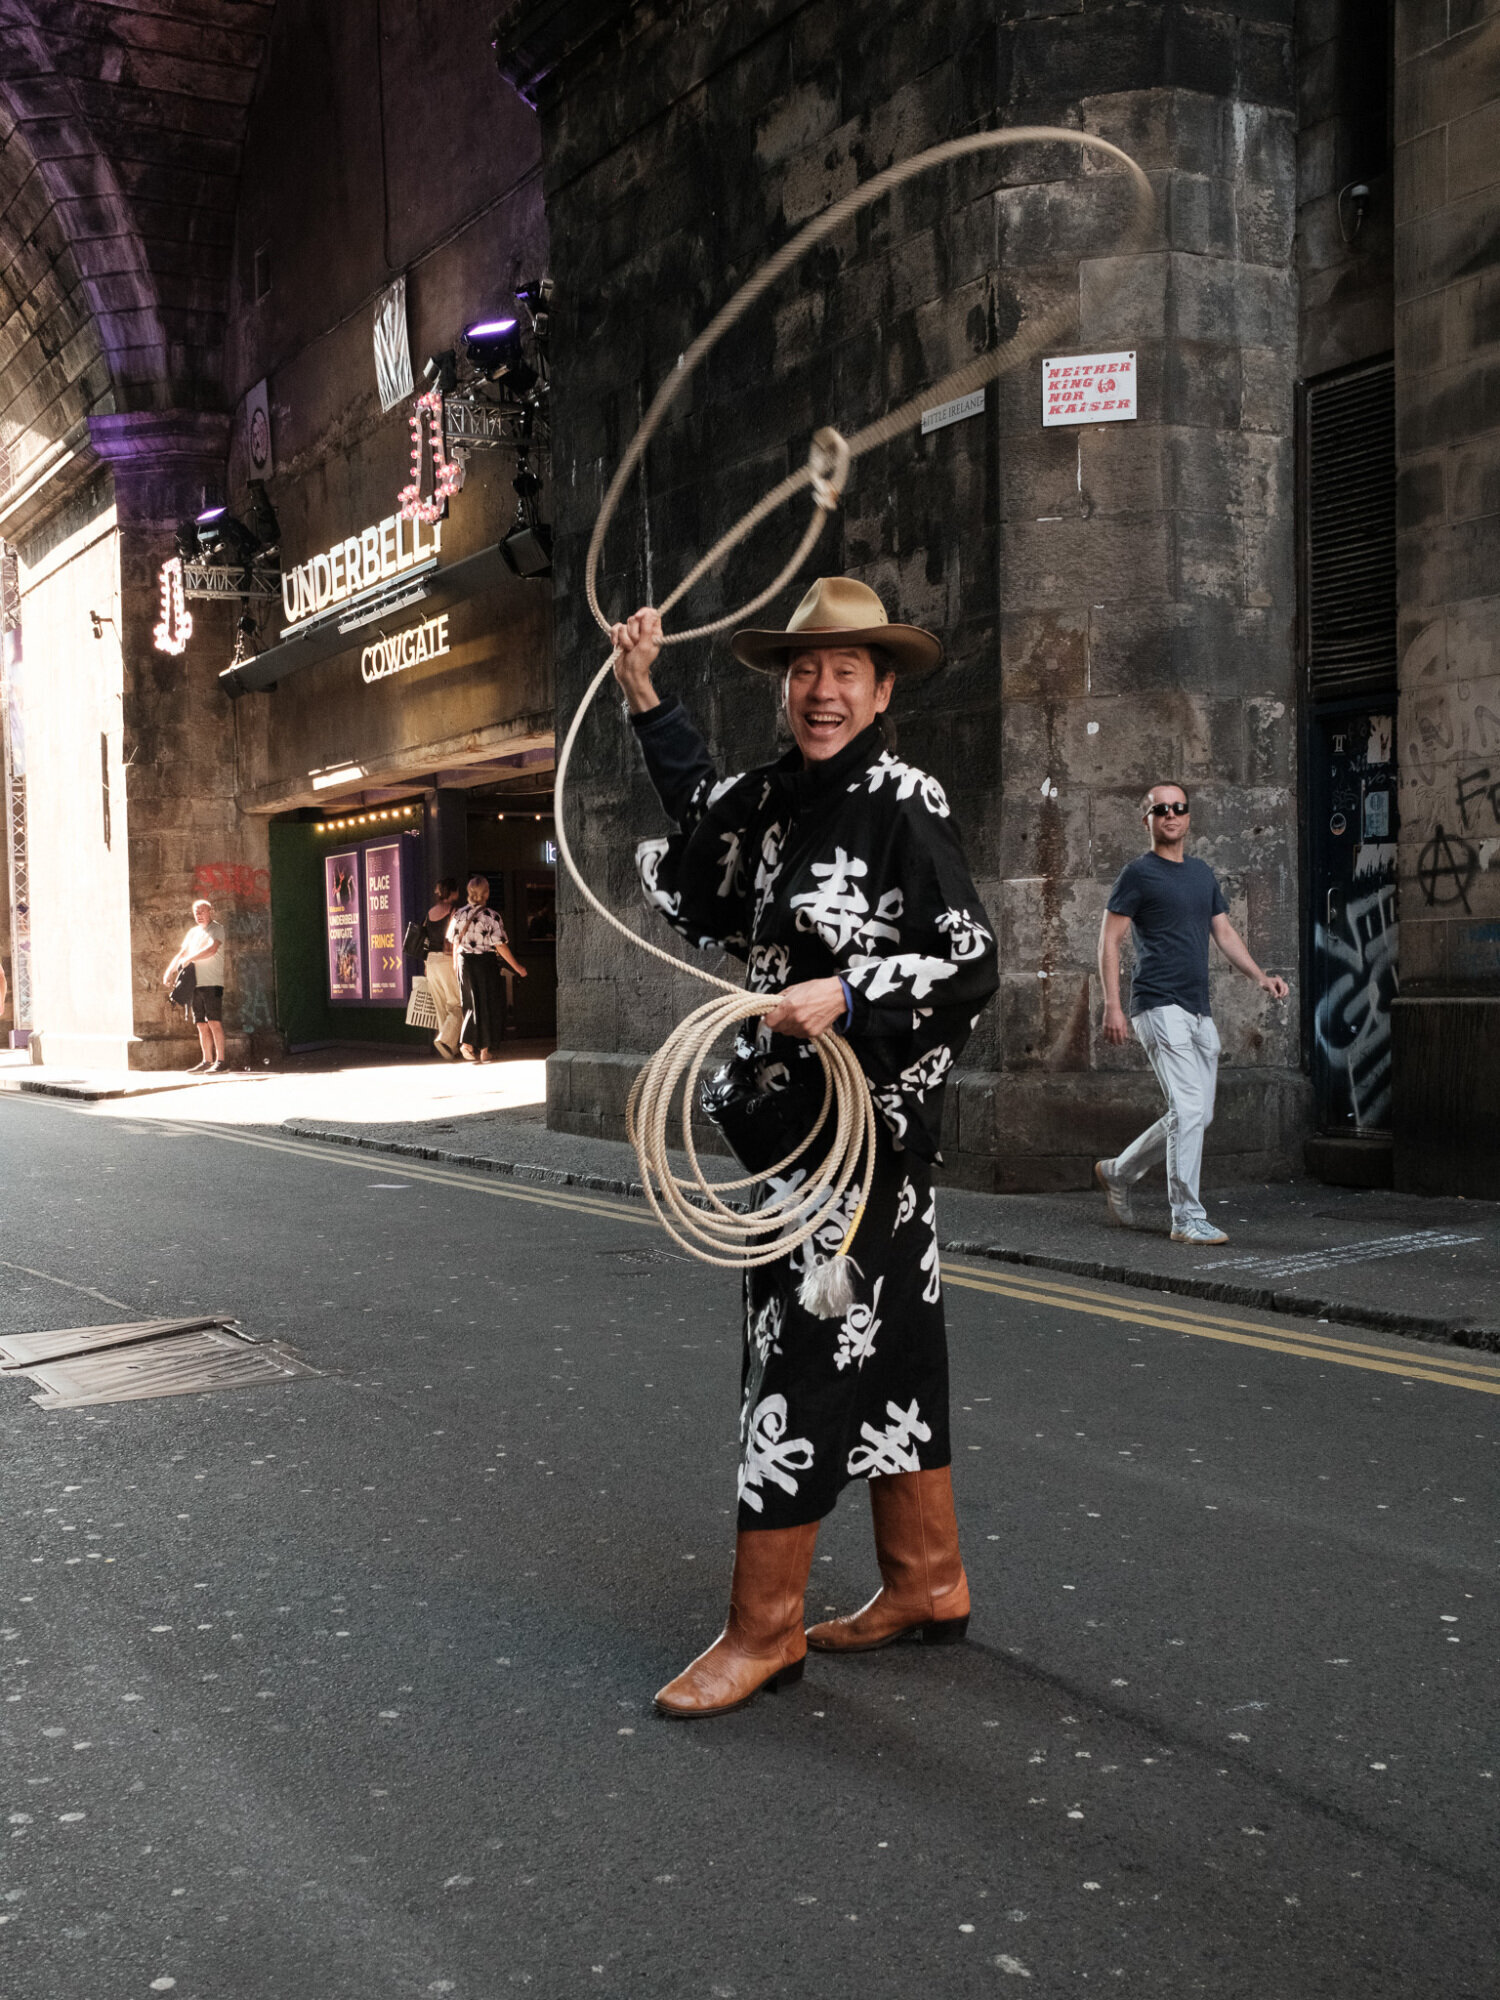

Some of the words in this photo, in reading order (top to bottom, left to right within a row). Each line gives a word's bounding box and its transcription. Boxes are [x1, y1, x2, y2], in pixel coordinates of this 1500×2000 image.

[1048, 391, 1084, 403] NOR
[281, 495, 444, 623] UNDERBELLY
[361, 614, 451, 684] COWGATE
[369, 875, 390, 892] PLACE
[370, 896, 379, 911] TO
[380, 895, 389, 910] BE
[330, 928, 353, 940] COWGATE
[371, 933, 395, 949] FRINGE
